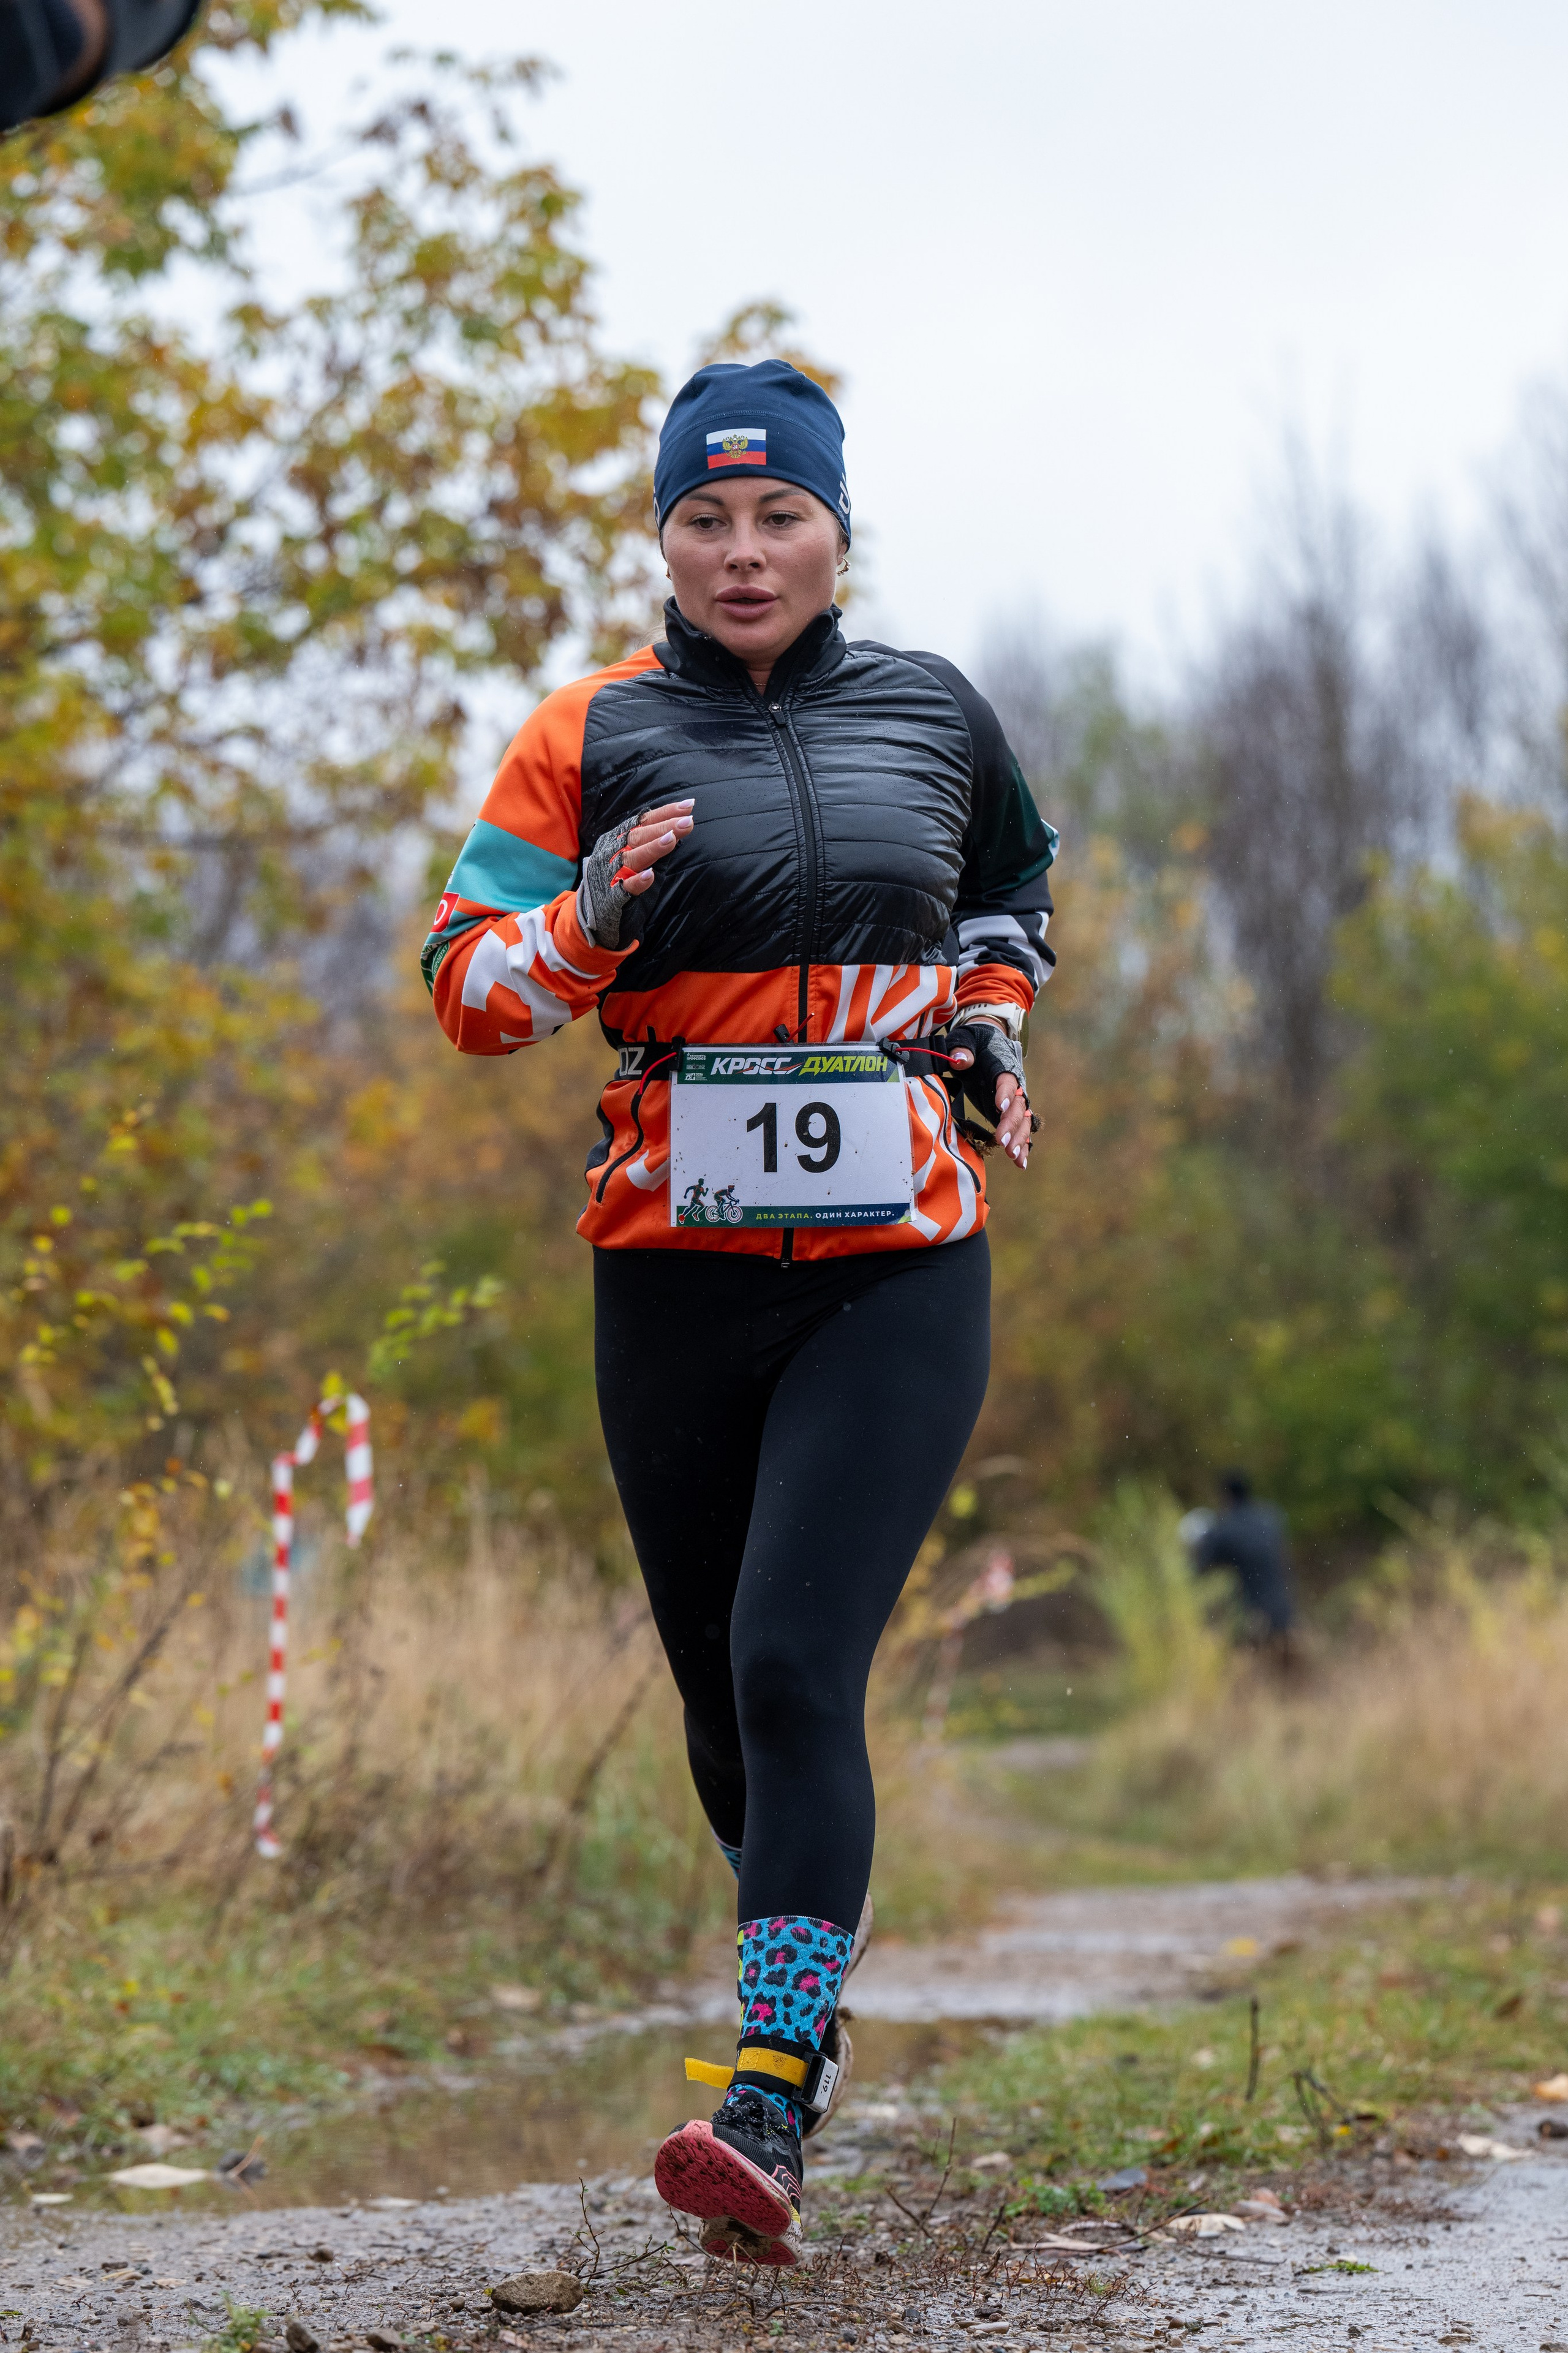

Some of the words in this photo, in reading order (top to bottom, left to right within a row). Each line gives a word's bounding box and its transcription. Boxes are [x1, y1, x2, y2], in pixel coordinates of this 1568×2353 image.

[710, 1057, 793, 1076] КРОСС
[798, 1056, 888, 1076] ДУАТЛОН
[746, 1101, 842, 1174] 19
